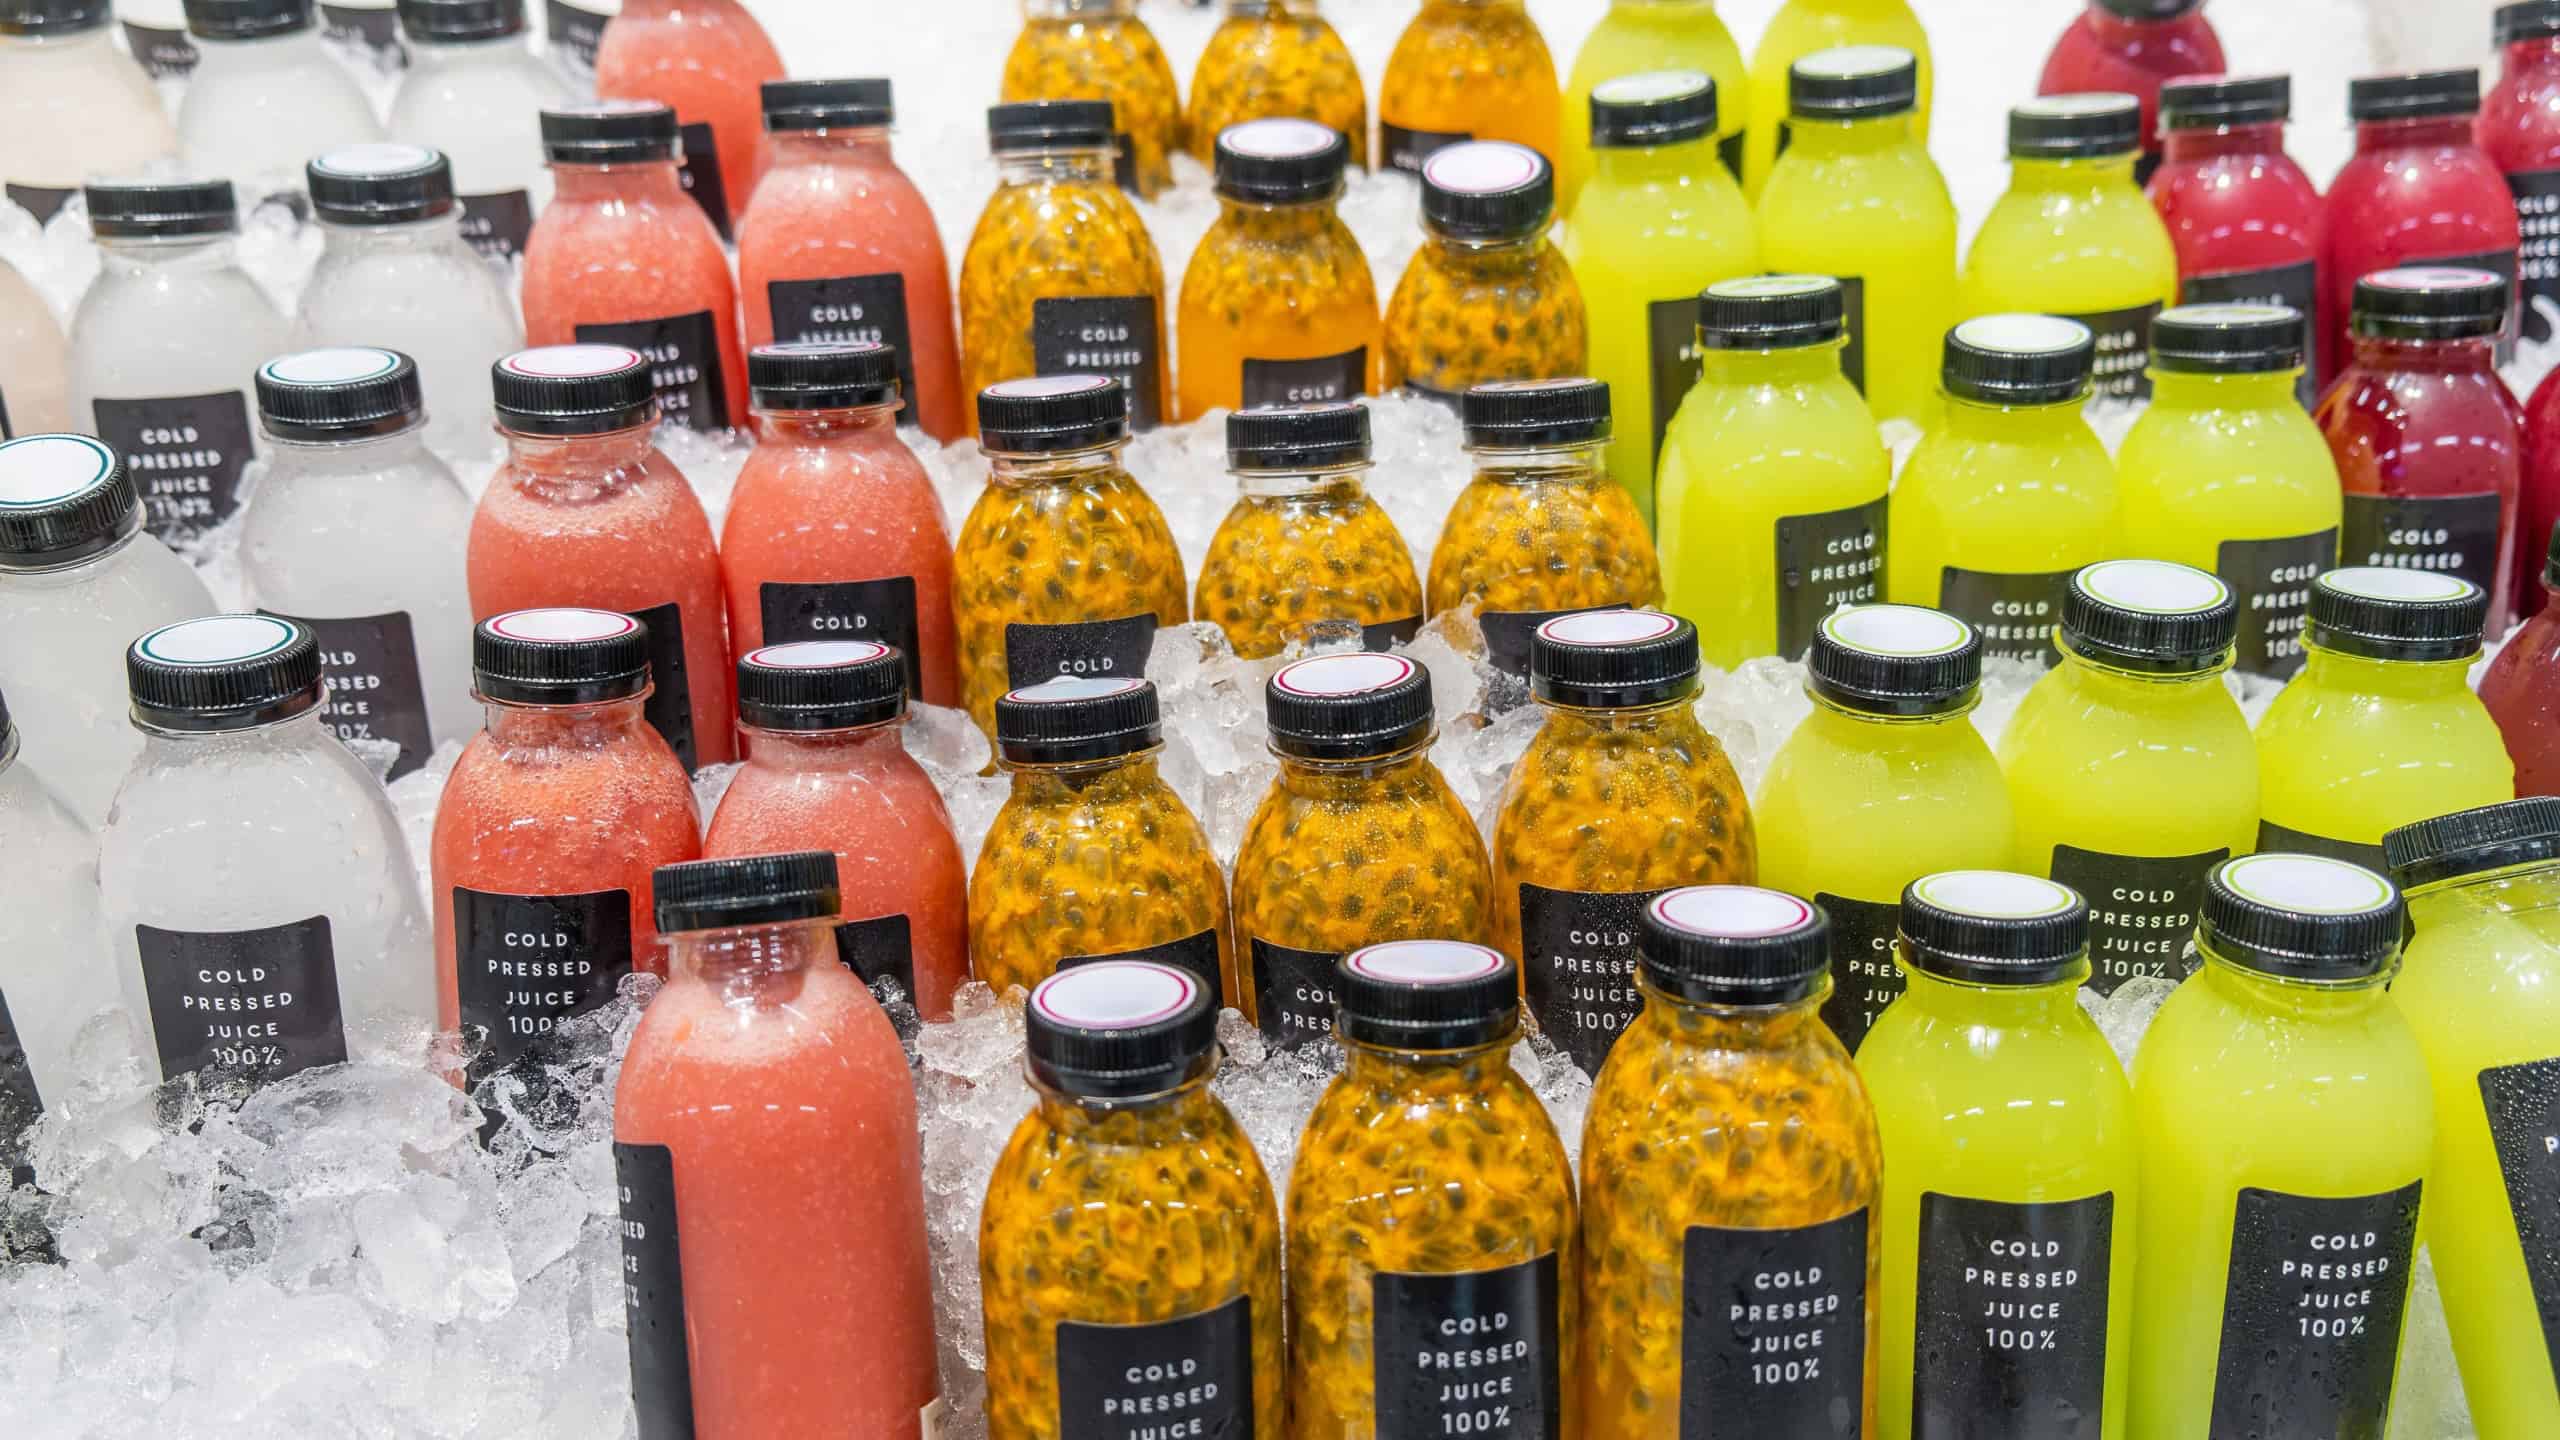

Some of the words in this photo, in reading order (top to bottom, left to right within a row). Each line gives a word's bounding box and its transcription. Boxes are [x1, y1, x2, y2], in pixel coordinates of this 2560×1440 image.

[811, 304, 863, 322] COLD
[1082, 327, 1129, 342] COLD
[642, 344, 680, 362] OLD
[1066, 351, 1142, 367] PRESSED
[652, 365, 698, 387] SSED
[657, 391, 690, 410] ICE
[1287, 384, 1335, 402] COLD
[141, 427, 198, 444] COLD
[128, 450, 222, 470] PRESSED
[152, 476, 211, 494] JUICE
[1827, 533, 1875, 555] COLD
[2389, 528, 2448, 546] COLD
[1811, 556, 1881, 583] PRESSED
[2368, 552, 2464, 570] PRESSED
[2270, 563, 2317, 583] COLD
[1825, 583, 1875, 606] JUICE
[2251, 589, 2309, 610] PRESS
[1992, 601, 2049, 616] COLD
[813, 615, 868, 630] COLD
[2265, 614, 2305, 634] JUIC
[1976, 624, 2058, 640] RESSE
[2266, 637, 2299, 658] 100
[319, 651, 356, 665] OLD
[1060, 657, 1113, 673] COLD
[326, 675, 380, 690] SSED
[320, 701, 369, 715] UICE
[2112, 888, 2175, 903] COLD
[2089, 910, 2189, 928] PRESSED
[504, 932, 568, 947] COLD
[1569, 930, 1630, 946] COLD
[1871, 938, 1899, 951] CO
[2103, 937, 2171, 953] JUICE
[488, 959, 591, 977] PRESSED
[1554, 956, 1635, 974] PRESSE
[1849, 960, 1904, 977] PRES
[2103, 959, 2165, 978] 100%
[199, 968, 265, 983] COLD
[183, 992, 292, 1011] PRESSED
[506, 991, 575, 1006] JUICE
[1296, 988, 1337, 1004] COL
[1571, 987, 1636, 1002] JUICE
[1282, 1010, 1331, 1031] PRES
[208, 1022, 278, 1039] JUICE
[212, 1046, 282, 1065] 100%
[1990, 1239, 2060, 1257] COLD
[2310, 1232, 2376, 1250] COLD
[1965, 1267, 2078, 1288] PRESSED
[2282, 1257, 2389, 1280] PRESSED
[1755, 1267, 1822, 1290] COLD
[1731, 1294, 1838, 1321] PRESSED
[2299, 1290, 2371, 1308] JUICE
[1985, 1302, 2060, 1319] JUICE
[1440, 1312, 1508, 1336] COLD
[2299, 1315, 2364, 1337] 100%
[1750, 1329, 1823, 1353] JUICE
[1986, 1328, 2055, 1350] 100%
[1418, 1340, 1528, 1369] PRESSED
[1126, 1358, 1196, 1383] COLD
[1752, 1357, 1819, 1384] 100%
[1440, 1376, 1513, 1401] JUICE
[1104, 1383, 1218, 1414] PRESSED
[1128, 1417, 1202, 1440] JUICE
[1442, 1405, 1511, 1434] 100%
